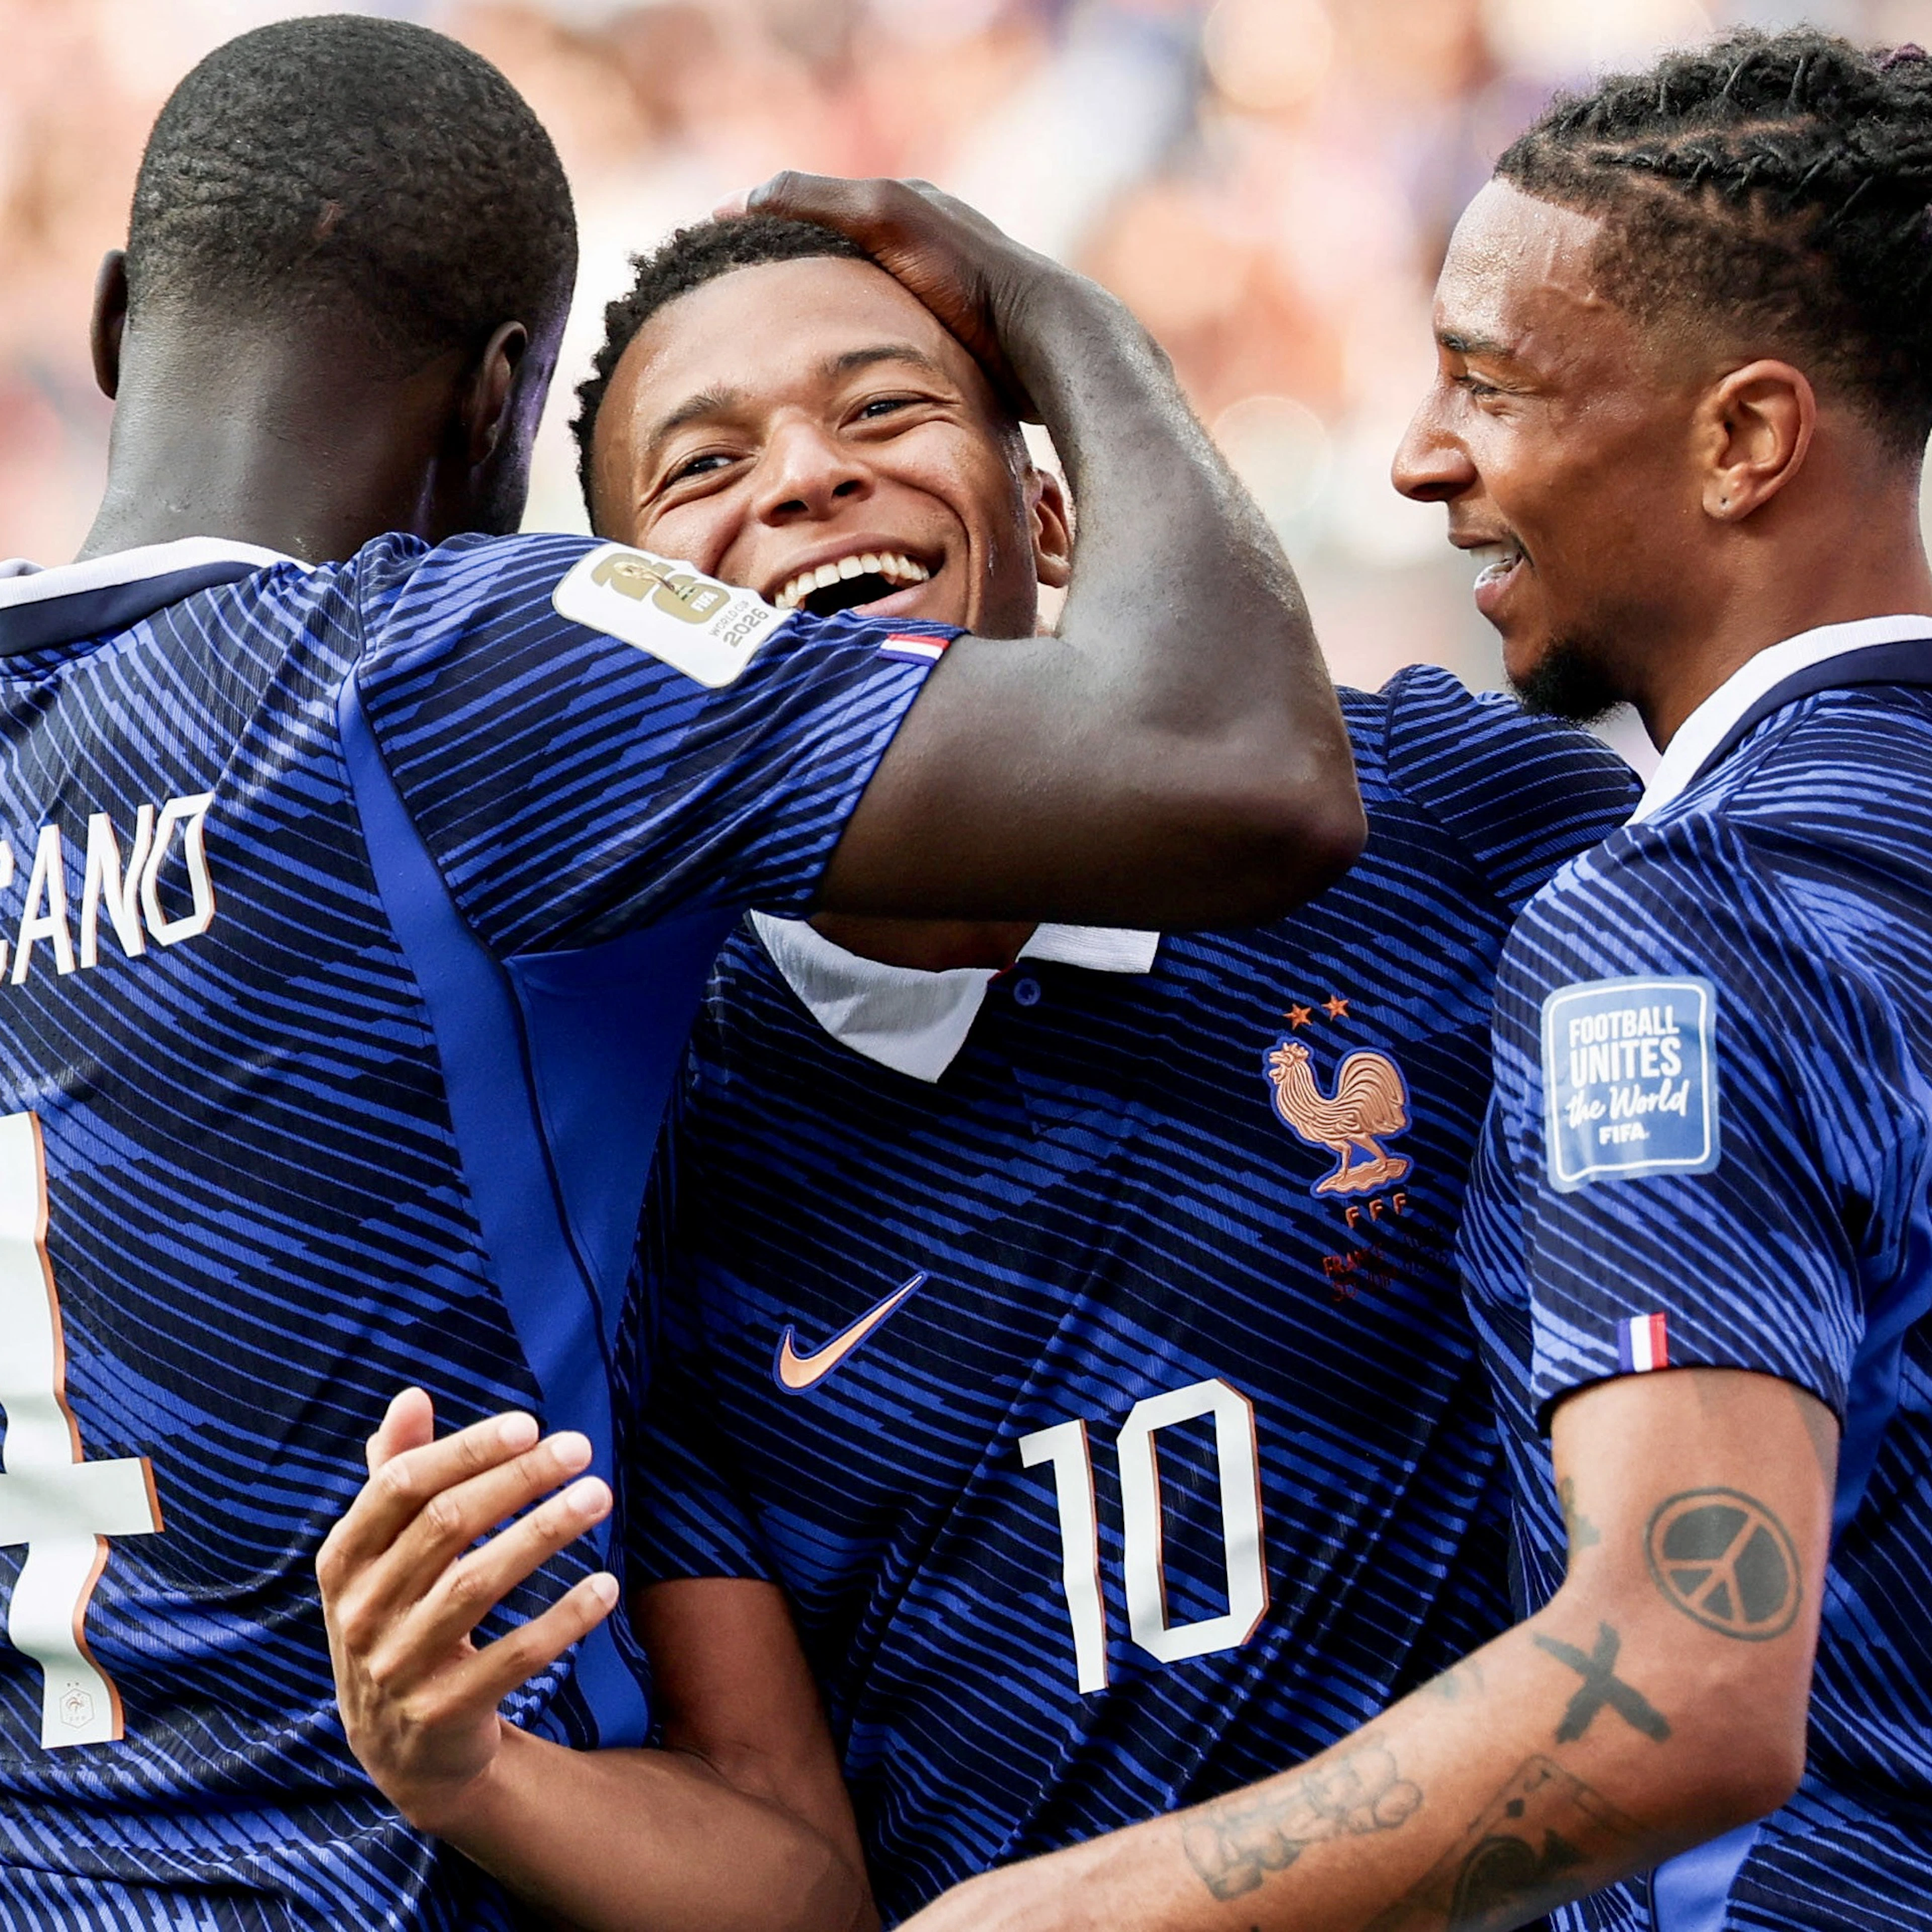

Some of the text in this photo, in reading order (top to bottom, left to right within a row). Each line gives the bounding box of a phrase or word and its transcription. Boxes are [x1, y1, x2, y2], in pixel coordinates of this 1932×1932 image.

[722, 608, 769, 648] 2026
[0, 789, 216, 985] ANO
[1568, 1005, 1680, 1048] FOOTBALL
[1570, 1036, 1682, 1088] UNITES
[1565, 1078, 1691, 1129] the World
[1598, 1121, 1646, 1145] FIFA
[1018, 1378, 1270, 1695] 10
